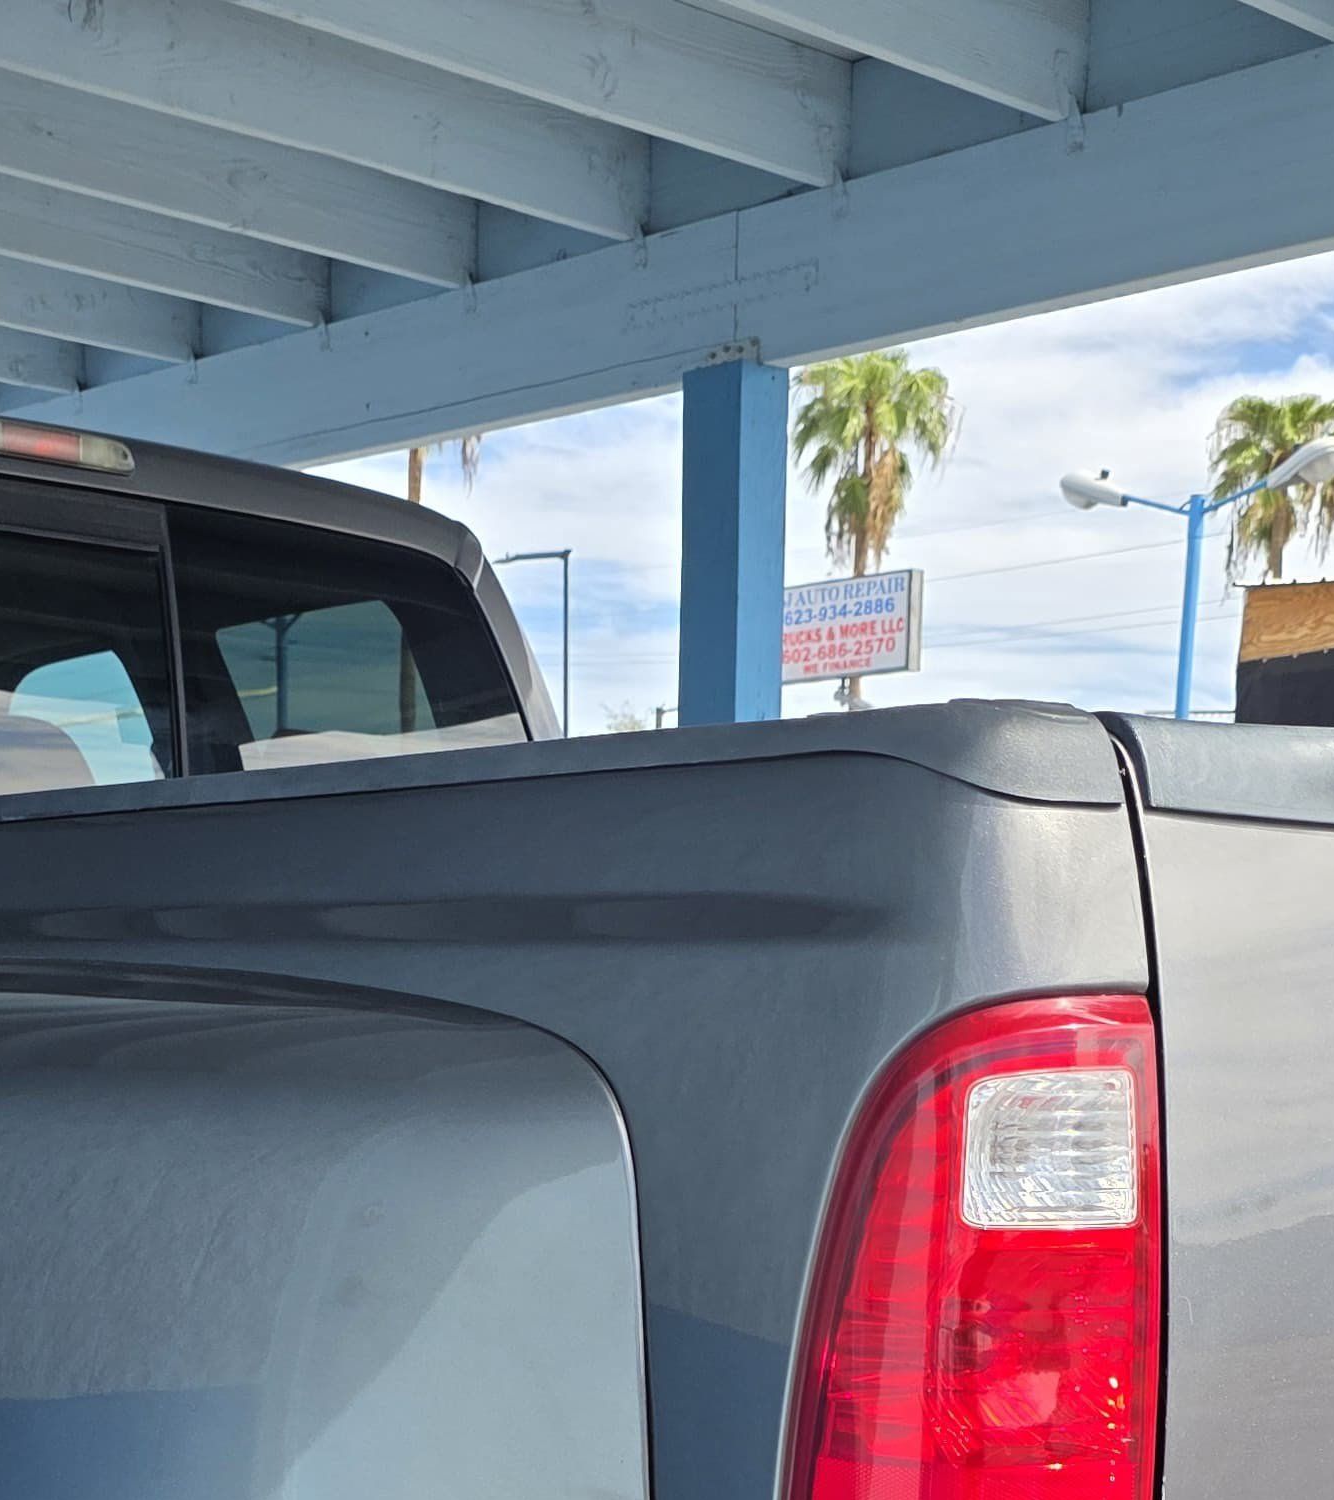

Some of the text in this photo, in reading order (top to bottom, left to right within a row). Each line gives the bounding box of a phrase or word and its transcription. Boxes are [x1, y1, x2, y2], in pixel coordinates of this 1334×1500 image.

[795, 586, 840, 606] AUTO
[843, 576, 905, 600] REPAIR
[785, 597, 895, 626] 623-934-2886
[840, 620, 877, 639] MORE
[881, 617, 905, 634] LLC
[783, 637, 896, 664] 602-686-2570
